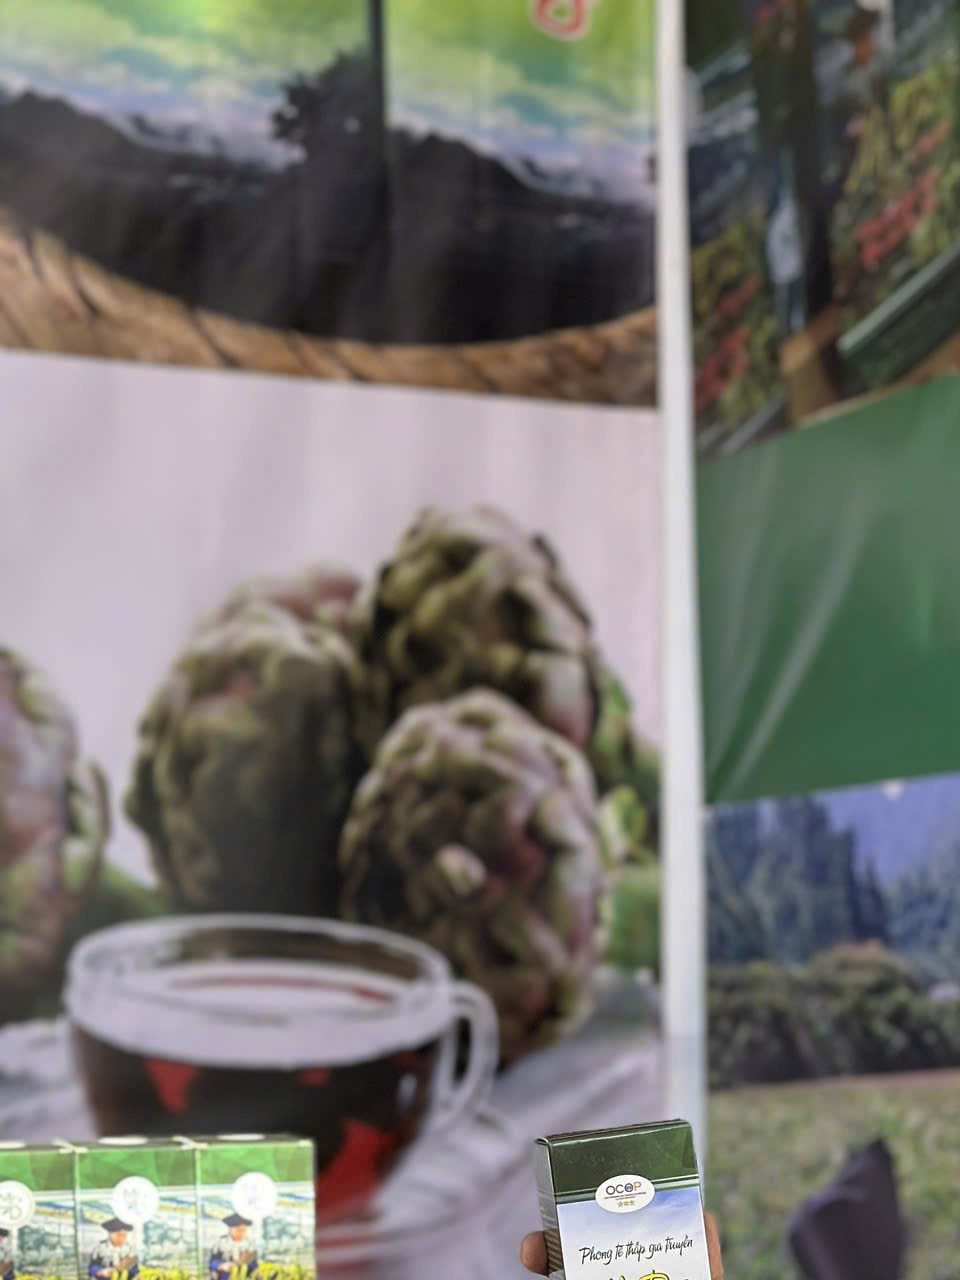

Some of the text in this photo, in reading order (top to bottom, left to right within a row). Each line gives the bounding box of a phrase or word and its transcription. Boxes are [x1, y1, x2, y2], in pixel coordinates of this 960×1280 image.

[605, 1181, 642, 1196] OCOP
[580, 1246, 613, 1266] Phong
[646, 1243, 663, 1260] gia
